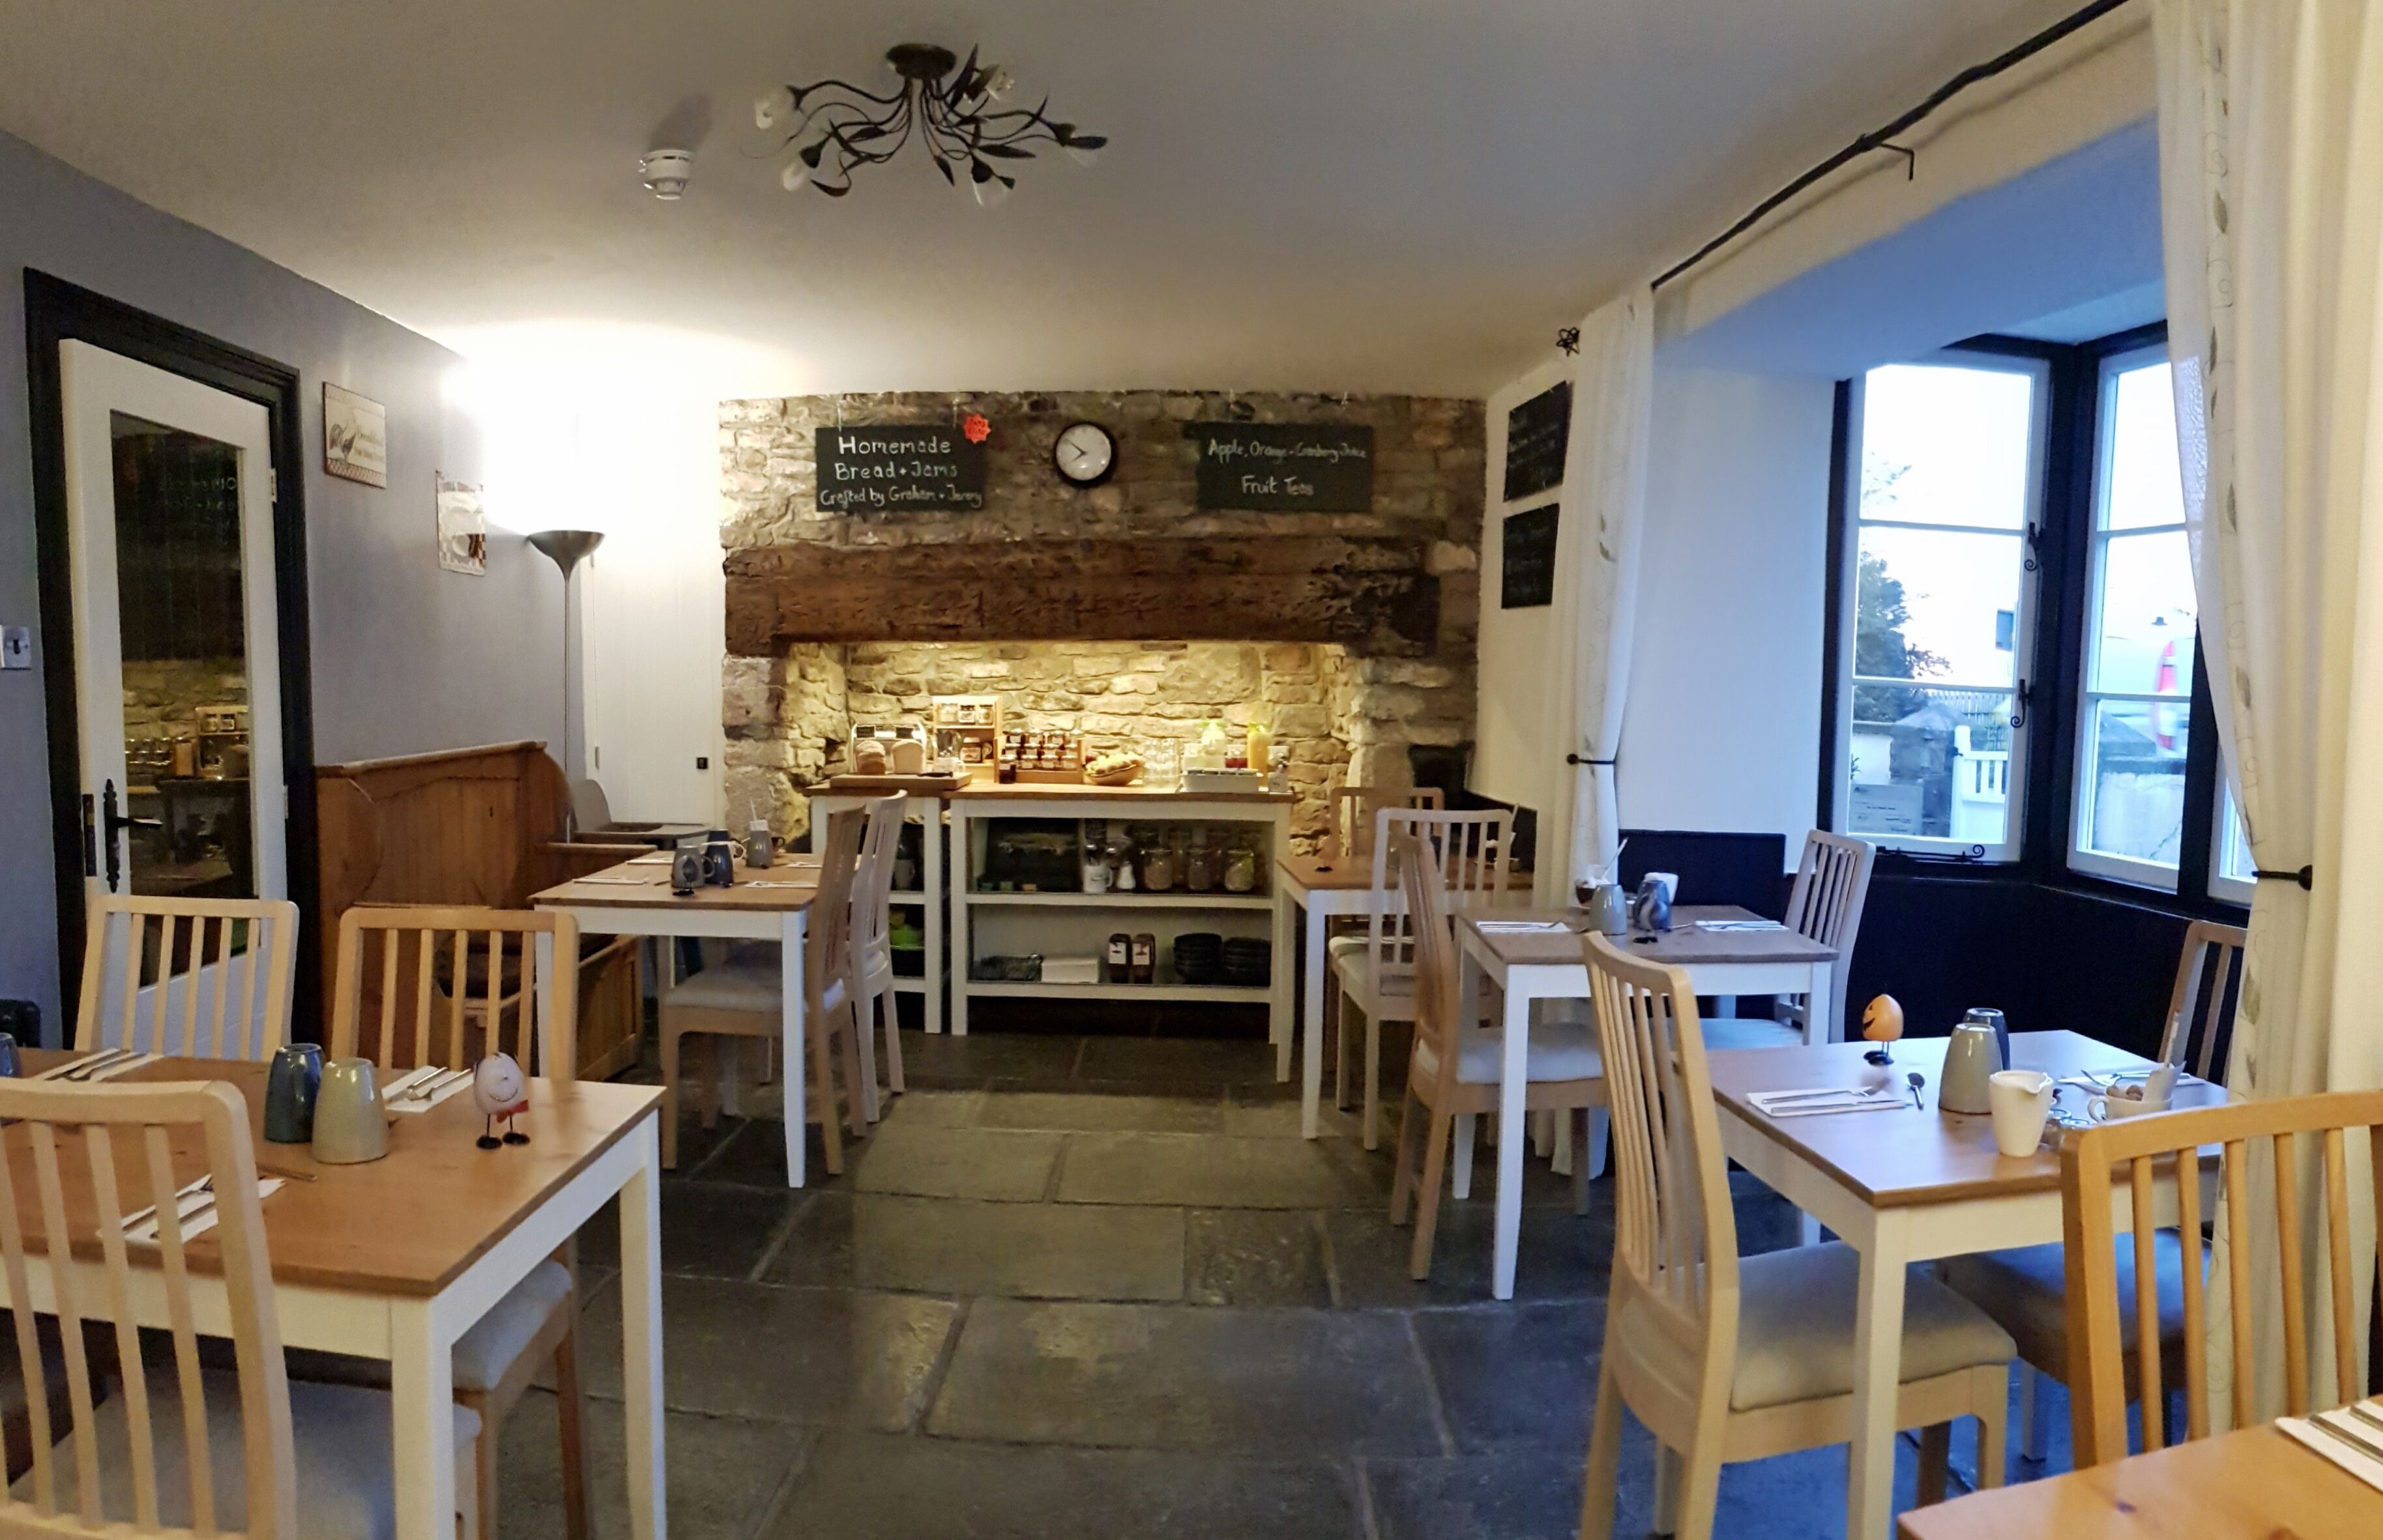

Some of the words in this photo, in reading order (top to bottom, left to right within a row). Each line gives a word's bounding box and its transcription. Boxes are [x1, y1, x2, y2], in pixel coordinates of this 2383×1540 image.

[838, 436, 951, 454] Homemade
[835, 461, 896, 480] Bread
[911, 461, 958, 477] Jams
[1242, 474, 1278, 494] Fruit
[820, 488, 866, 508] Crafted
[870, 487, 885, 507] by
[889, 484, 937, 501] Graham
